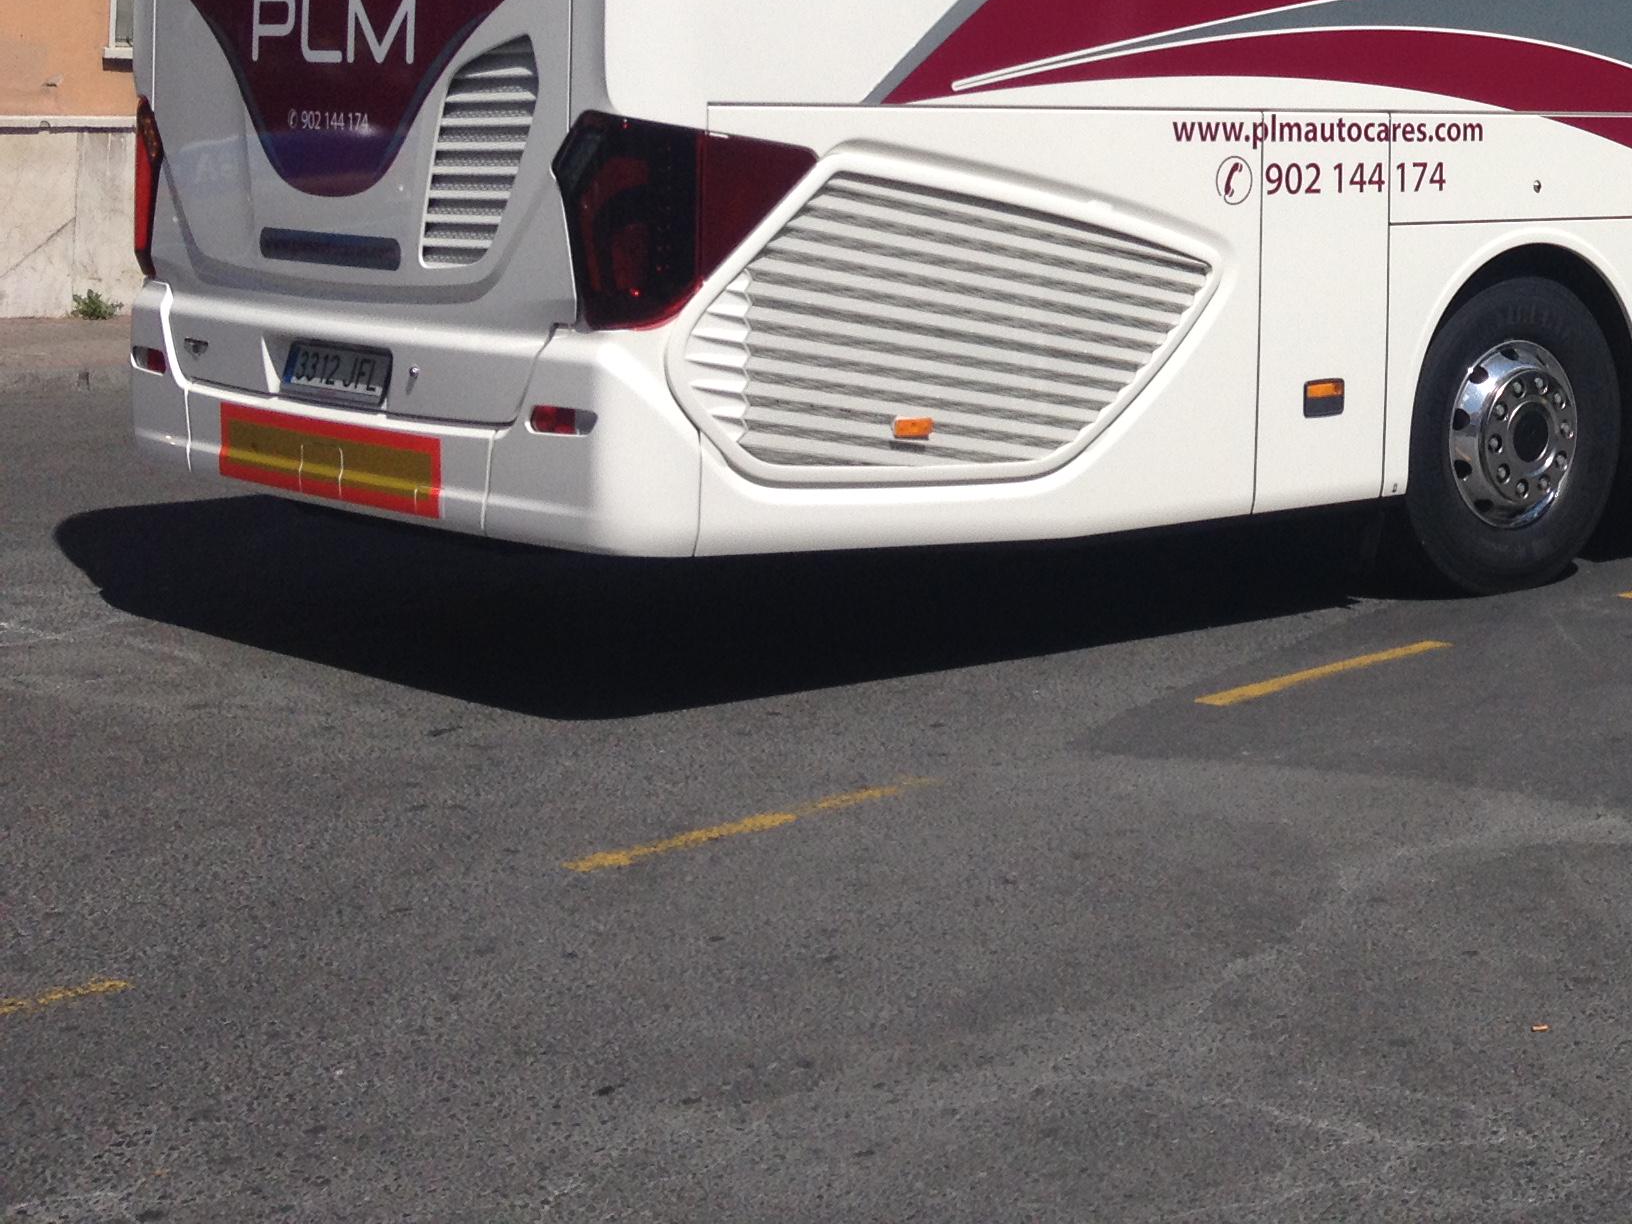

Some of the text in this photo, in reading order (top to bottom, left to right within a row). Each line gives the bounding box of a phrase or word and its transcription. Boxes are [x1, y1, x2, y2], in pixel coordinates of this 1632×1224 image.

[301, 110, 369, 132] 902 144 174
[1172, 114, 1484, 150] www.plmautocares.com
[1265, 161, 1446, 195] 902 144 174
[295, 350, 377, 392] 3312 JFL
